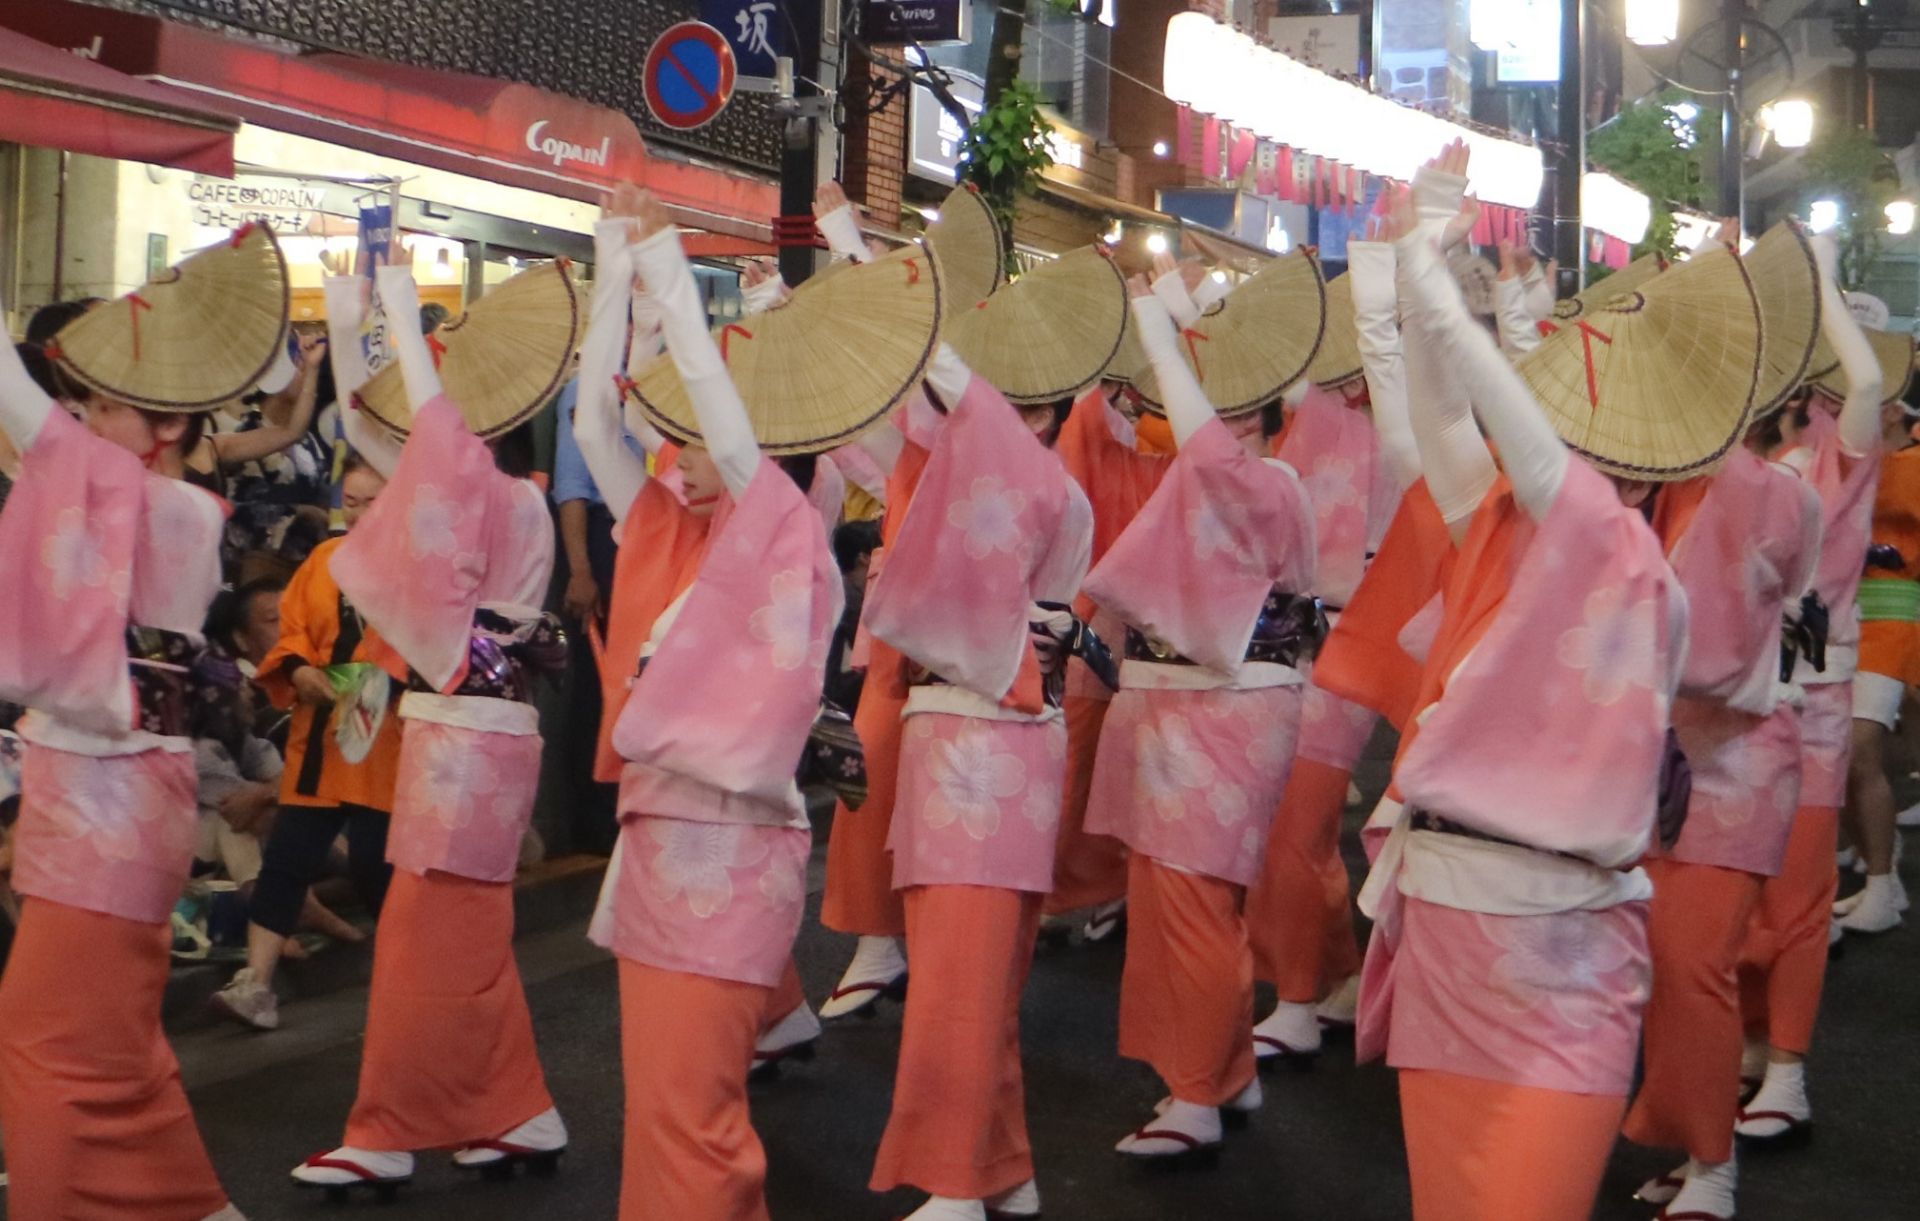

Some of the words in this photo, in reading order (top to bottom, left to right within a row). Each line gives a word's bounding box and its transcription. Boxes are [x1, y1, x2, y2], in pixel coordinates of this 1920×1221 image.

[734, 2, 778, 62] 坂
[189, 183, 240, 202] CAFE
[260, 188, 314, 207] COPAIN
